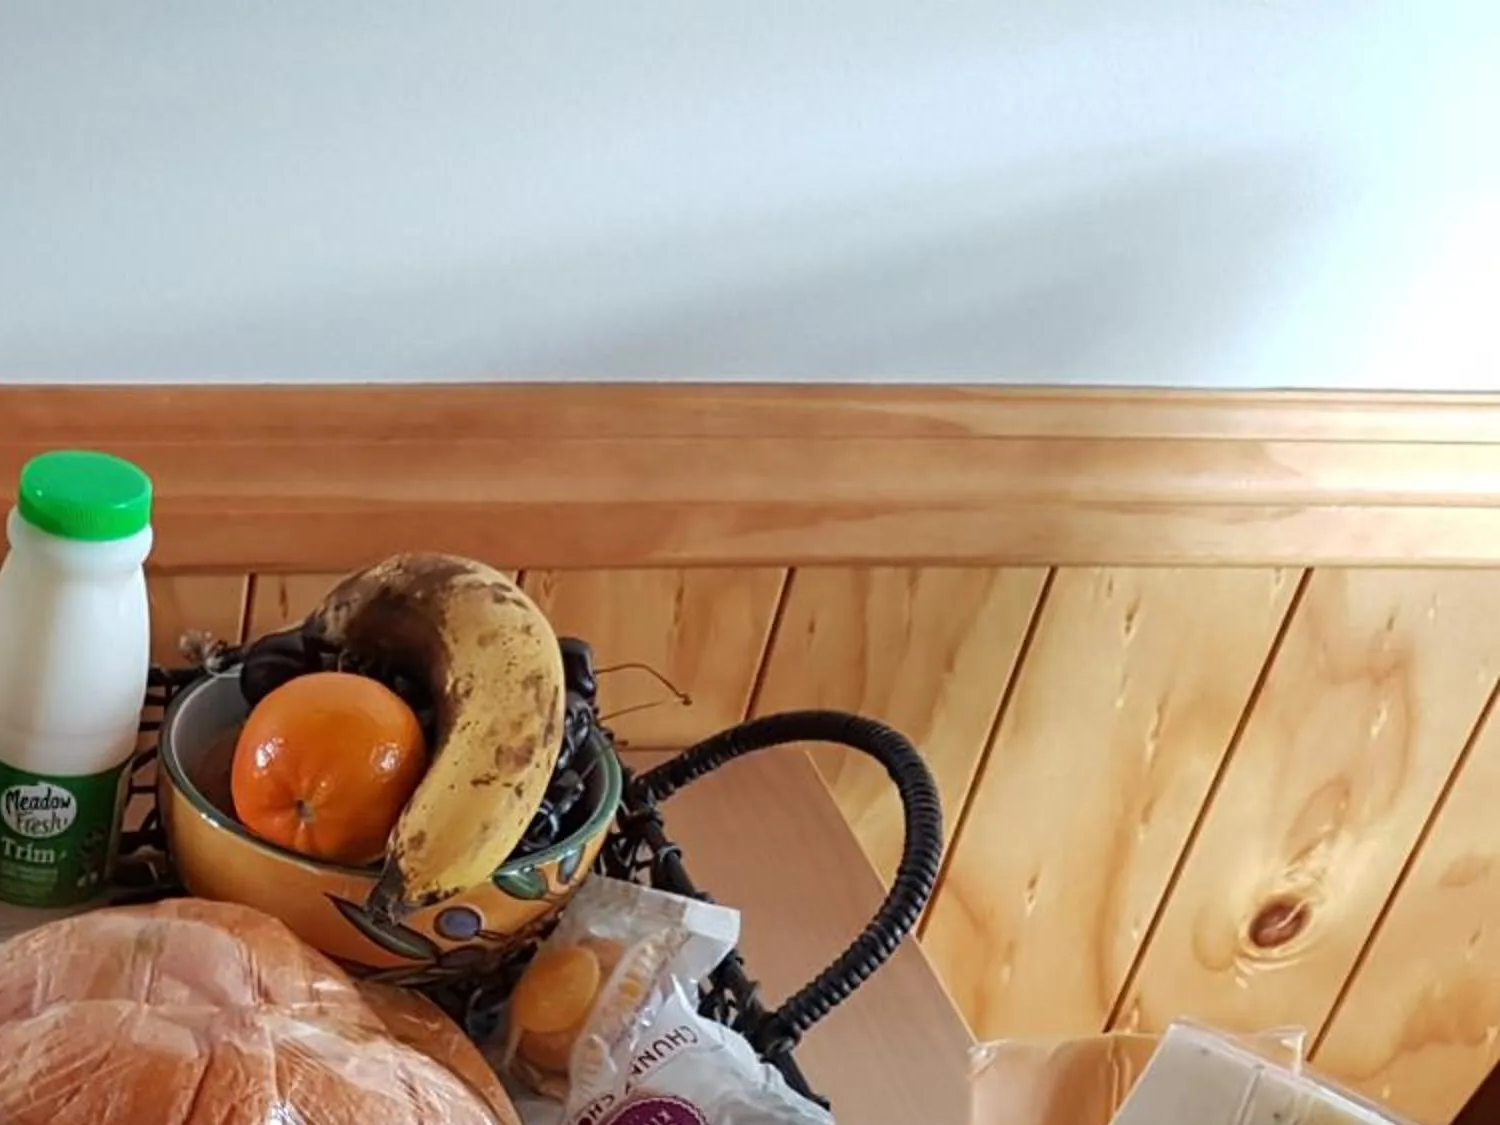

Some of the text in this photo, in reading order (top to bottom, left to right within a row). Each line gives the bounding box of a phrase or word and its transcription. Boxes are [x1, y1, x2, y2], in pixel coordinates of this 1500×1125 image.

[5, 788, 72, 811] Meadow
[16, 810, 66, 833] Fresh
[1, 837, 56, 864] Trim
